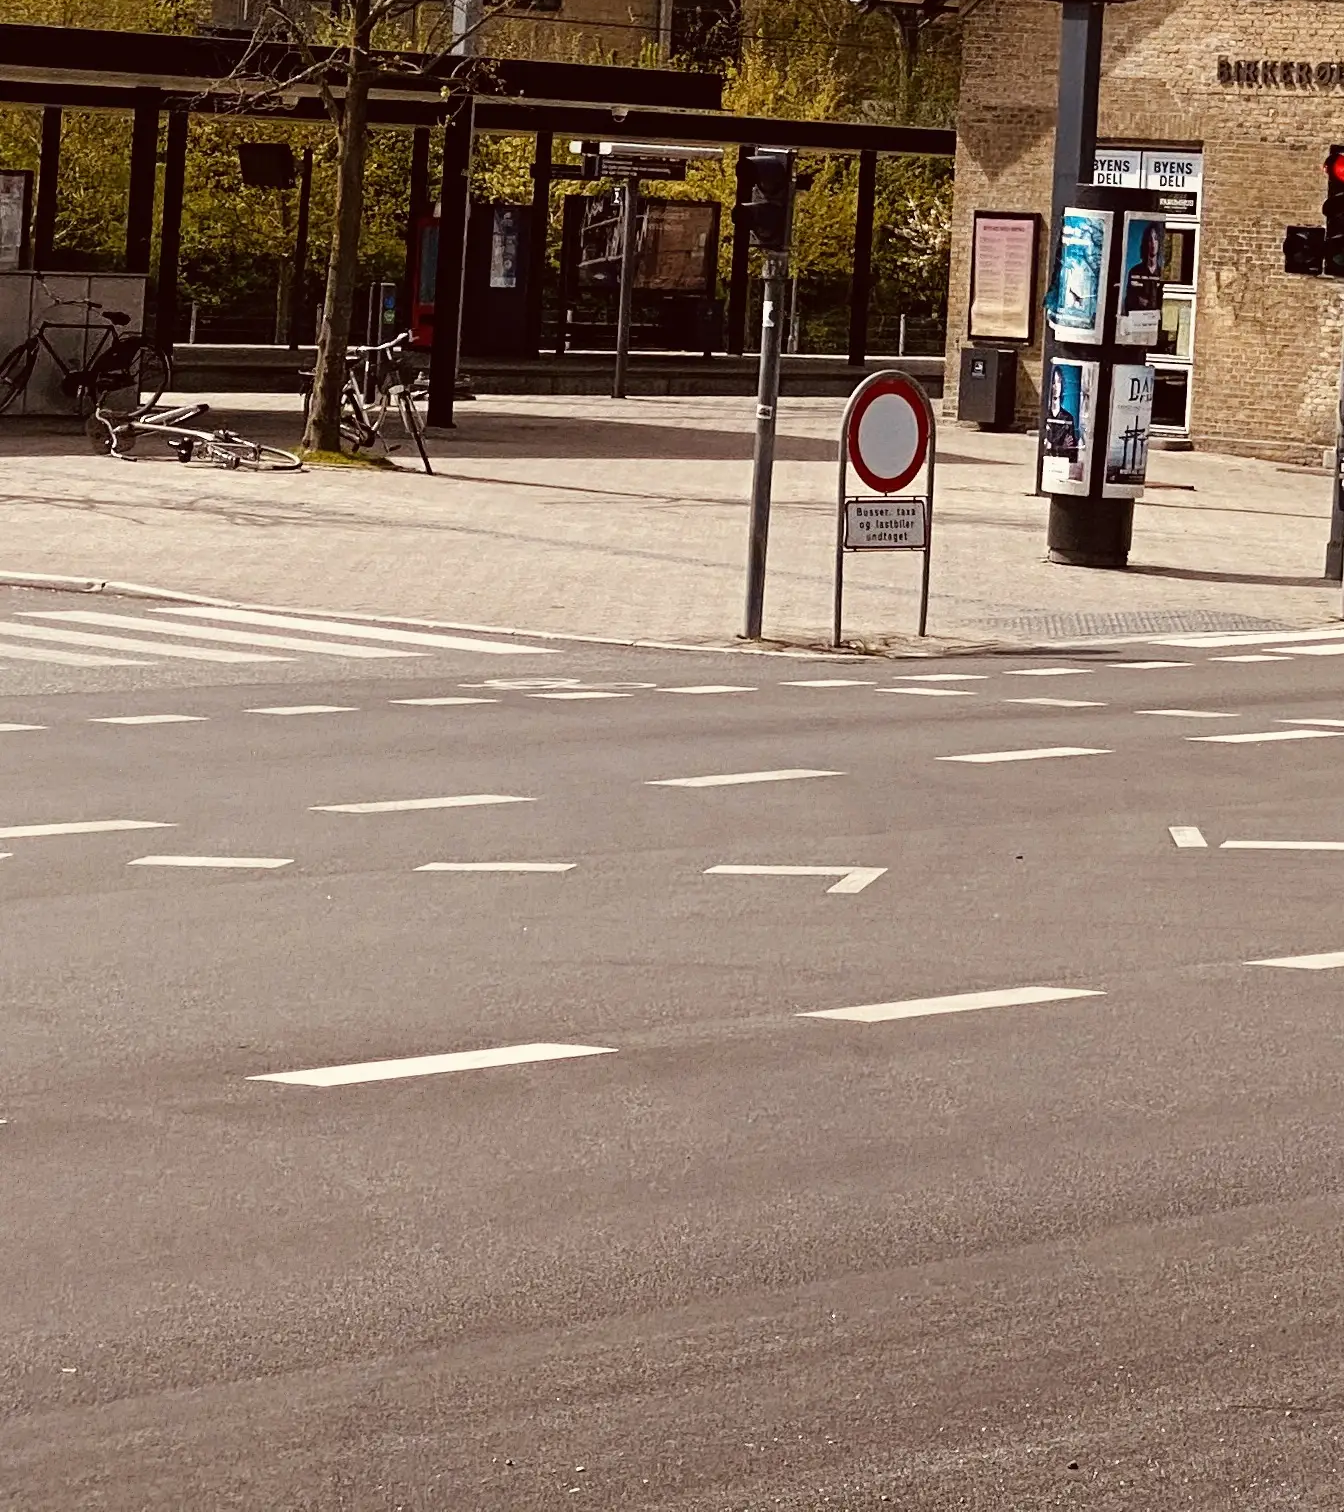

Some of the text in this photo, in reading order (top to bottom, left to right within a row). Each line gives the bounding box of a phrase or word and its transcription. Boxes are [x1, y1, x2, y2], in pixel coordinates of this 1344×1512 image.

[1153, 161, 1193, 175] BYENS
[1097, 173, 1122, 185] DELI
[1159, 175, 1185, 188] DELI
[896, 507, 916, 517] taxa
[859, 519, 915, 530] og lastbiler
[865, 531, 908, 543] undtaget
